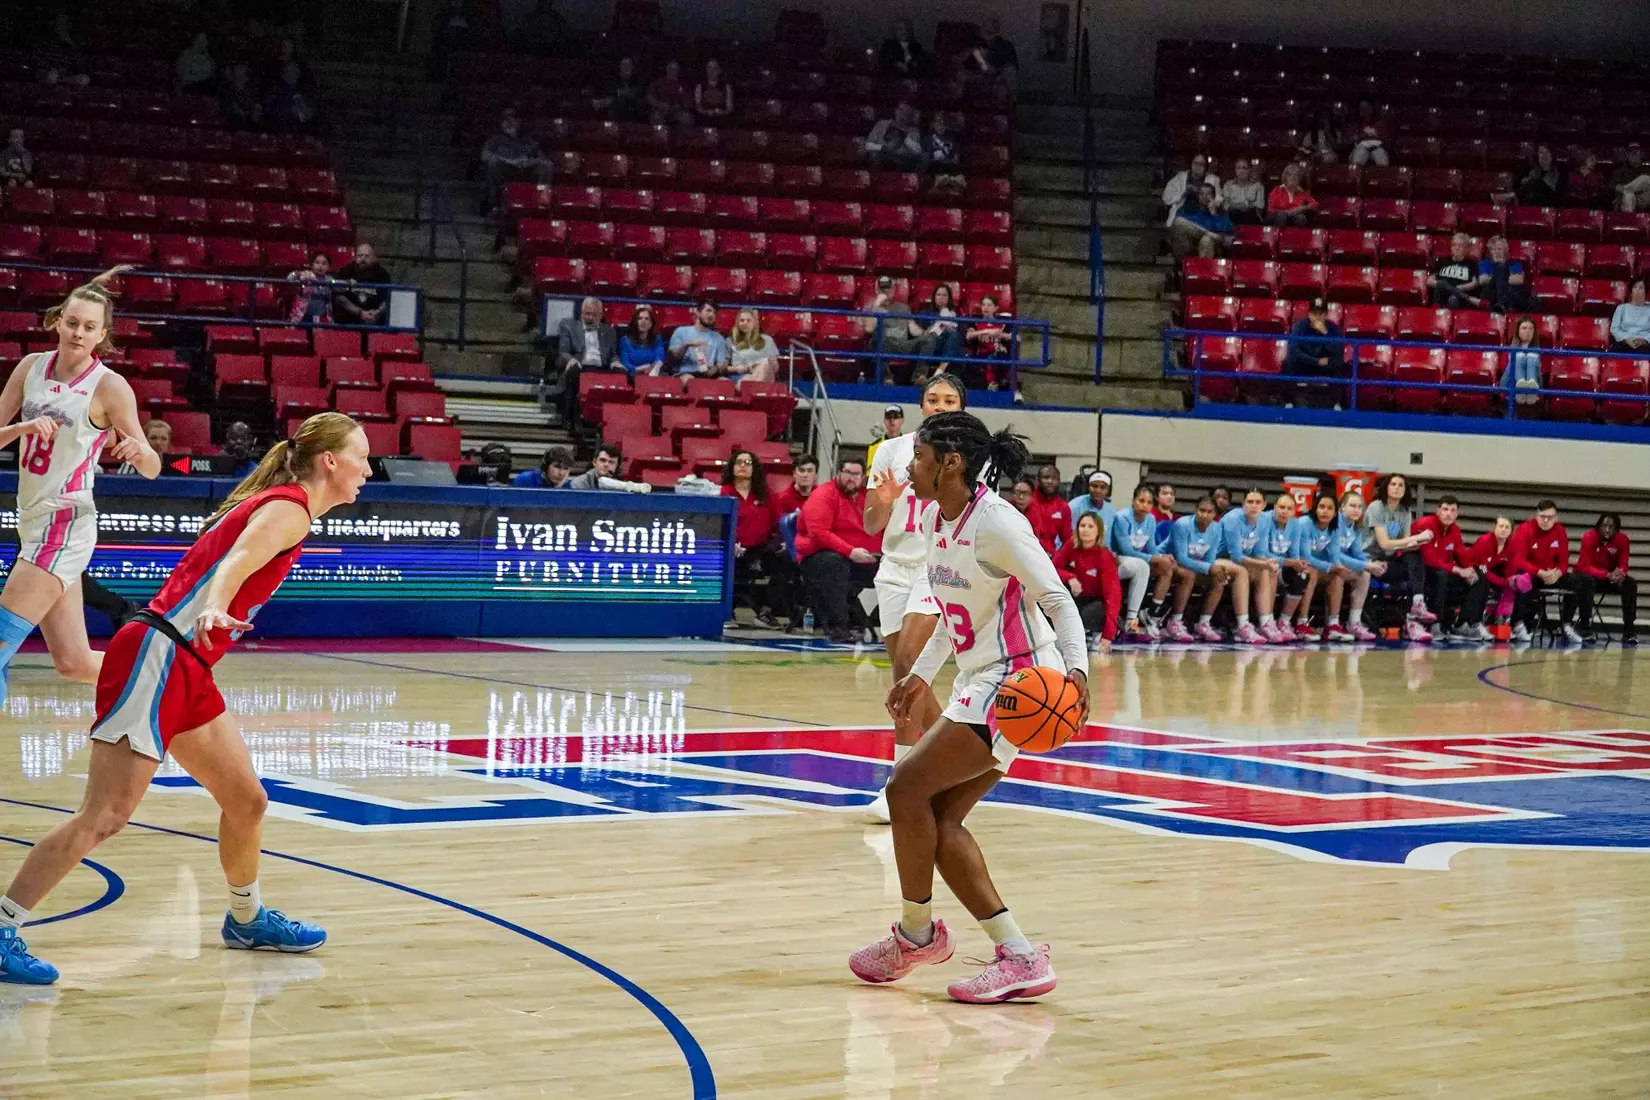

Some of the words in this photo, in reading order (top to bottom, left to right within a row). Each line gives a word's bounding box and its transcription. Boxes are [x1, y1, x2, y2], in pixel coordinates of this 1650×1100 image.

[22, 433, 54, 476] 18
[191, 460, 212, 472] POSS.
[495, 516, 578, 552] Ivan
[589, 518, 696, 554] Smith
[495, 560, 693, 584] FURNITURE
[933, 596, 976, 655] 3
